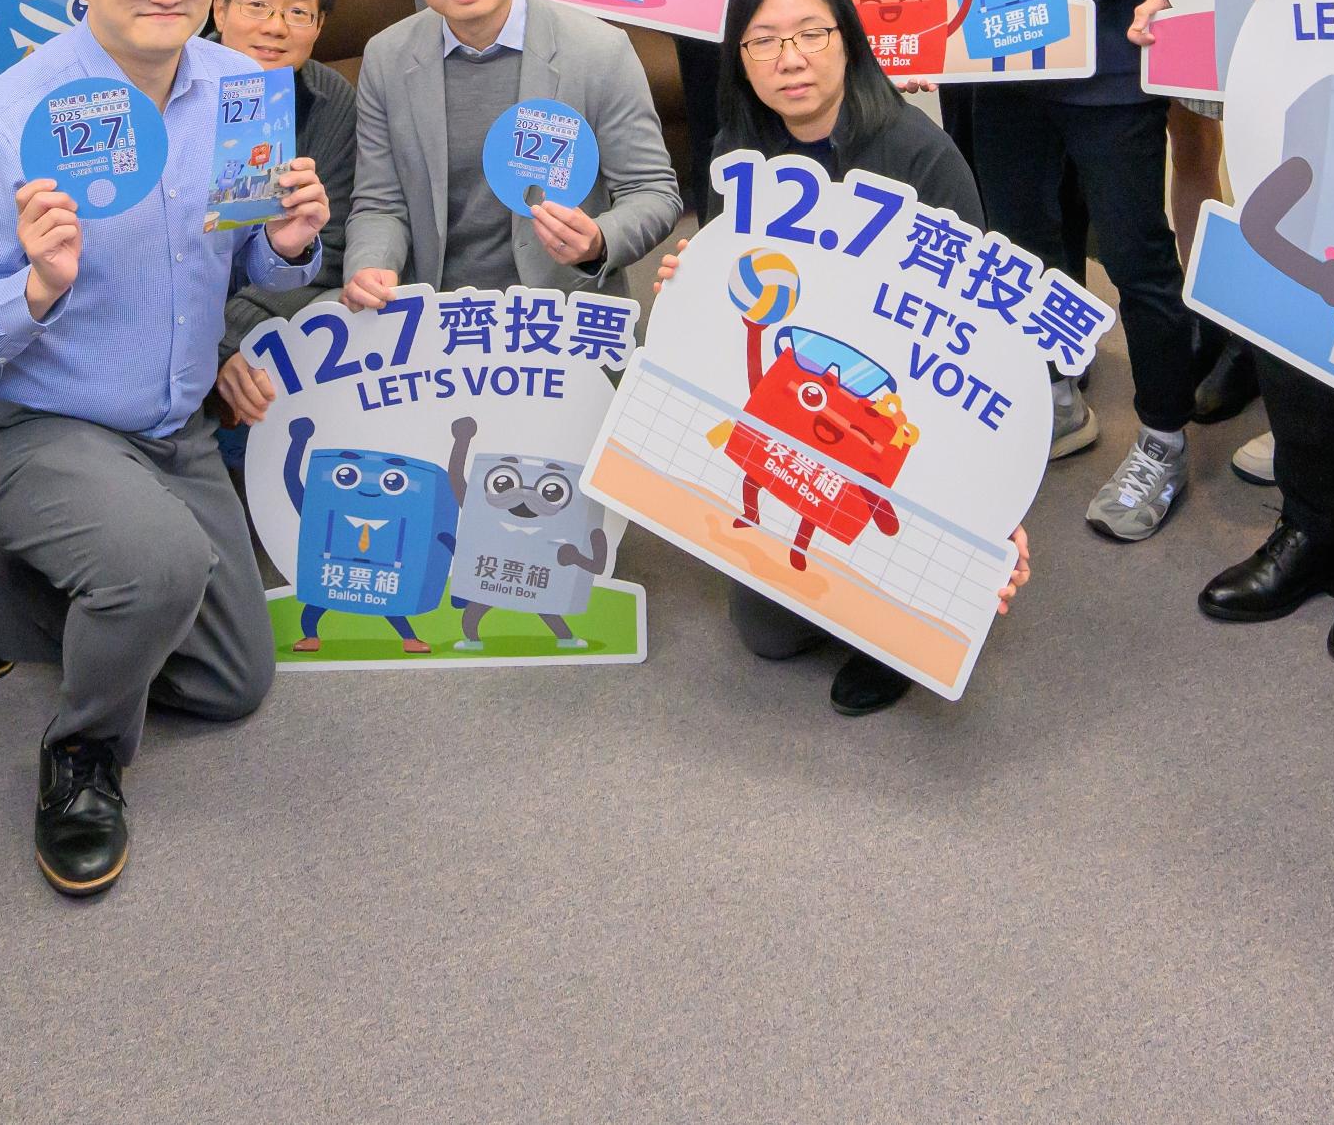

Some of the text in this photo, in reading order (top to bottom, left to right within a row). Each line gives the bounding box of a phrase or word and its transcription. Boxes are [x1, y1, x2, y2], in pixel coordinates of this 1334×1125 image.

[983, 3, 1049, 39] 投票箱
[994, 27, 1045, 49] Ballot Box
[892, 56, 911, 67] Box
[723, 161, 1105, 367] 12.7 齊投票
[872, 283, 977, 355] LET'S
[252, 295, 631, 396] 12.7 齊投票
[357, 366, 566, 412] LET'S VOTE
[909, 342, 1013, 433] VOTE
[762, 435, 847, 503] 投票箱
[762, 456, 821, 509] Ballot Box
[320, 563, 401, 597] 投票箱
[475, 554, 551, 590] 投票箱
[480, 580, 537, 600] Ballot Box
[328, 588, 387, 607] Ballot Box
